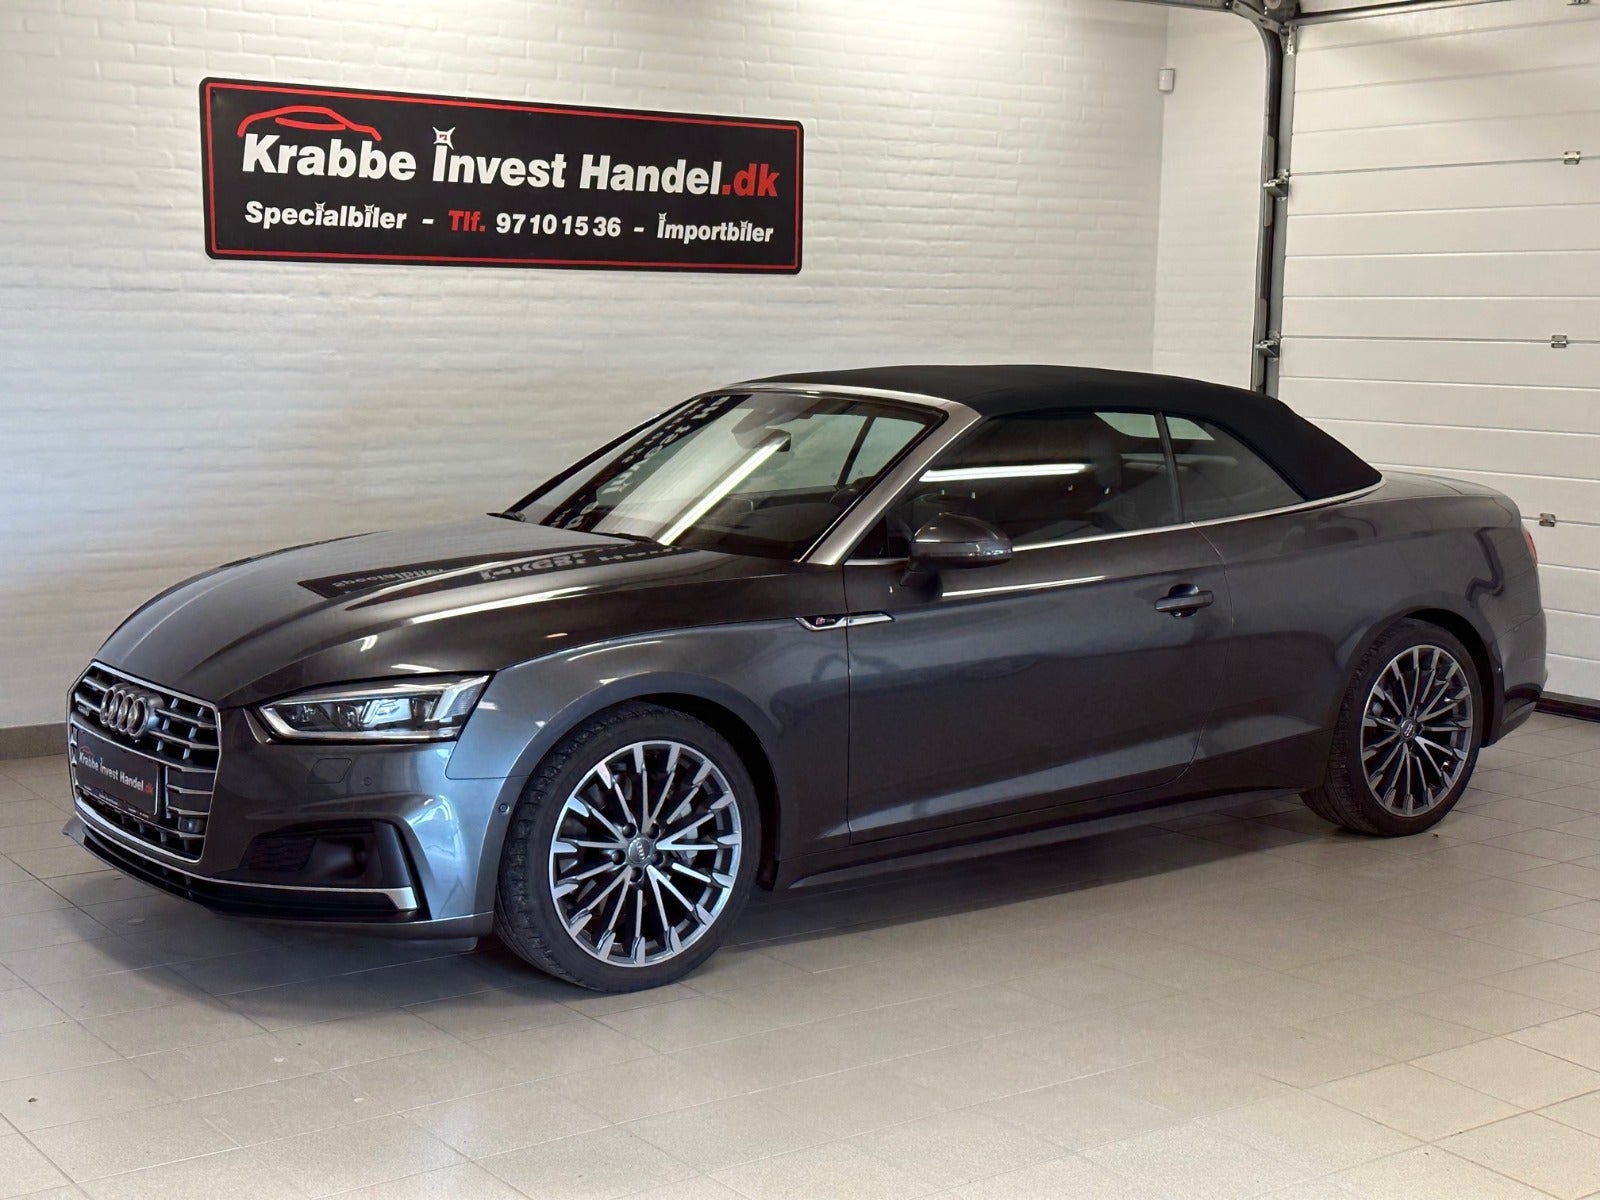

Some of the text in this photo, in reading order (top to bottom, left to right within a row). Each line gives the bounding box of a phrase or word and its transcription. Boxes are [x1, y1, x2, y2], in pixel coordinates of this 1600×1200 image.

[242, 127, 781, 197] Krabbe Invest Handel.dk
[244, 200, 407, 230] Specialbiler
[448, 210, 486, 232] Tlf.
[656, 212, 774, 244] Importbiler
[79, 751, 99, 771] Krabbe
